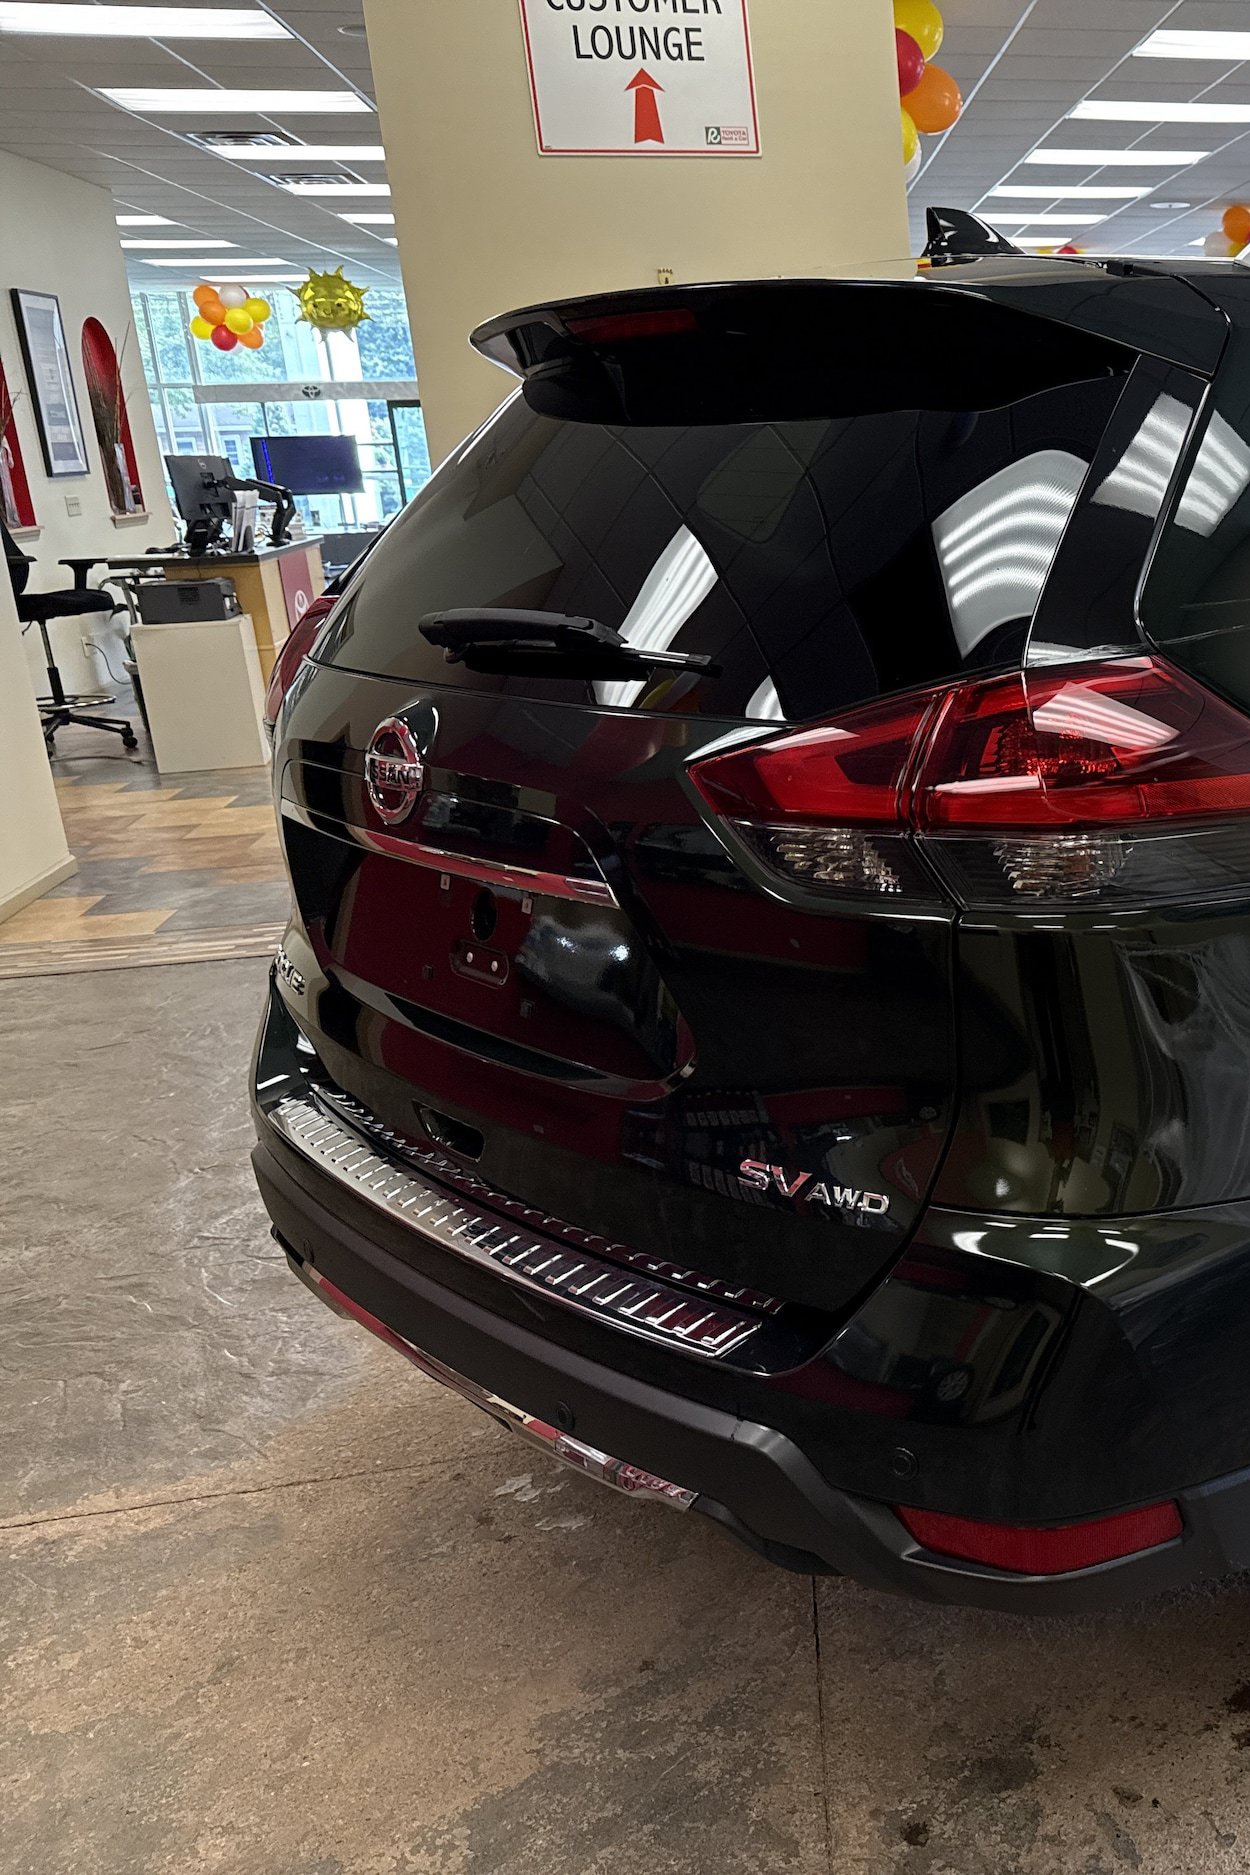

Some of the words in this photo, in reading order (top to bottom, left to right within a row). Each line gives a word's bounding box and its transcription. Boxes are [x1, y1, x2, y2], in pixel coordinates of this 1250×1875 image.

[572, 25, 705, 61] LOUNGE
[738, 1158, 813, 1197] SV
[804, 1182, 890, 1215] AWD
